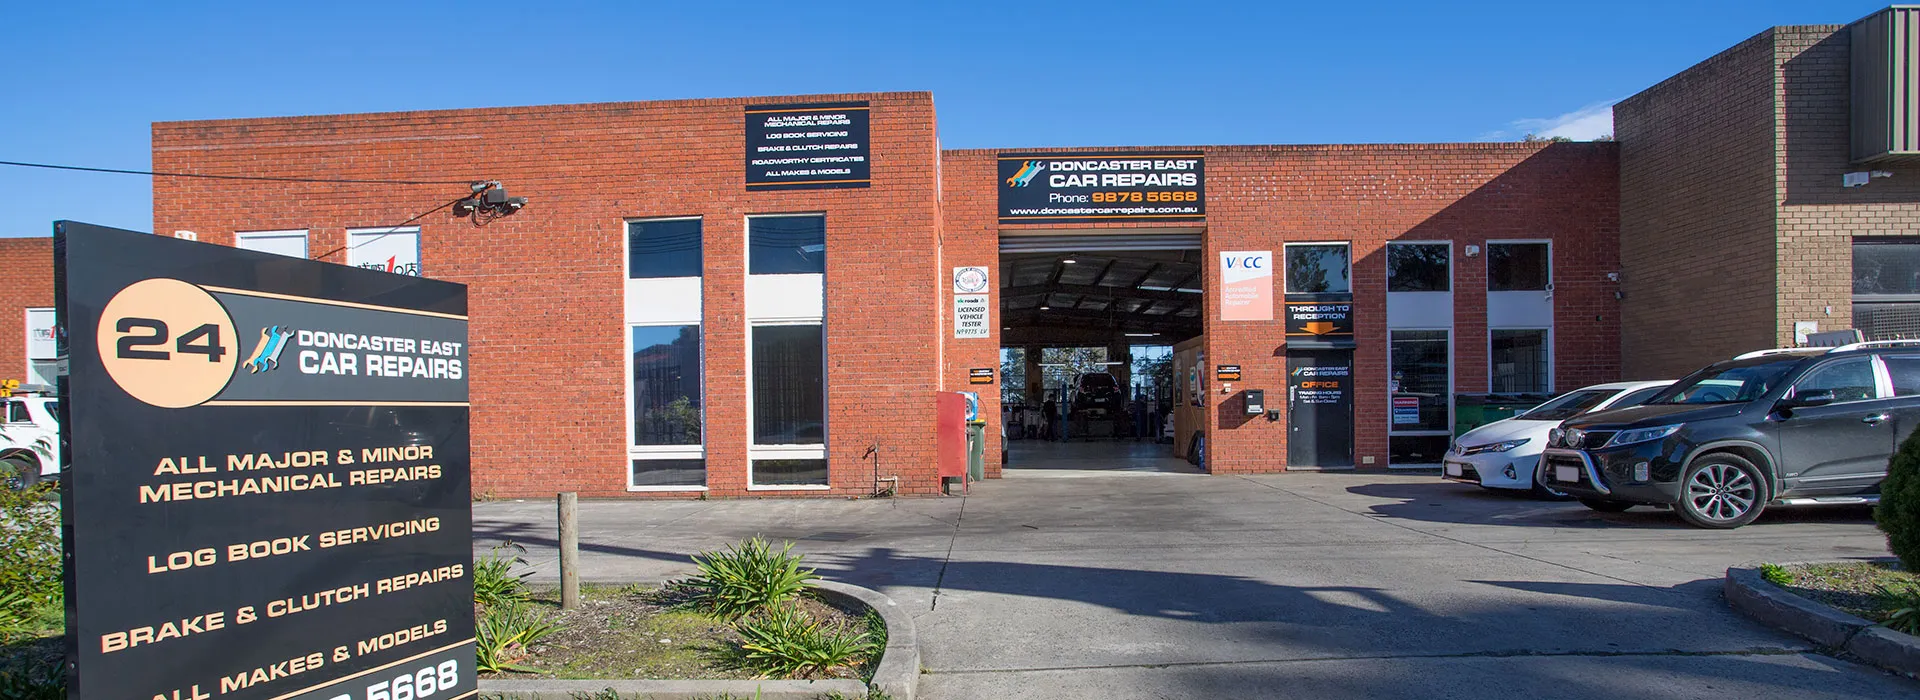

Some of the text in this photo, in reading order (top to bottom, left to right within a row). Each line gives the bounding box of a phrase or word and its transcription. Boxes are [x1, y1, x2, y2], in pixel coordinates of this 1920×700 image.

[1050, 160, 1197, 171] DONCASTER EAST
[1050, 173, 1197, 188] CAR REPAIRS
[1010, 206, 1198, 215] www.doncastercarrepairs.com.au
[1050, 191, 1198, 203] Phone: 9878 5668
[1226, 256, 1263, 268] VACC
[116, 317, 226, 362] 24
[298, 330, 461, 357] DONCASTER EAST
[300, 350, 463, 380] CAR REPAIRS
[154, 446, 433, 476] ALL MAJOR & MINOR
[139, 464, 442, 504] MECHANICAL REPAIRS
[148, 517, 440, 574] LOG BOOK SERVICING
[101, 564, 464, 654] BRAKE & CLUTCH REPAIRS
[220, 652, 324, 695] MAKES
[332, 645, 350, 663] &
[357, 618, 448, 657] MODELS
[366, 658, 459, 700] 5668
